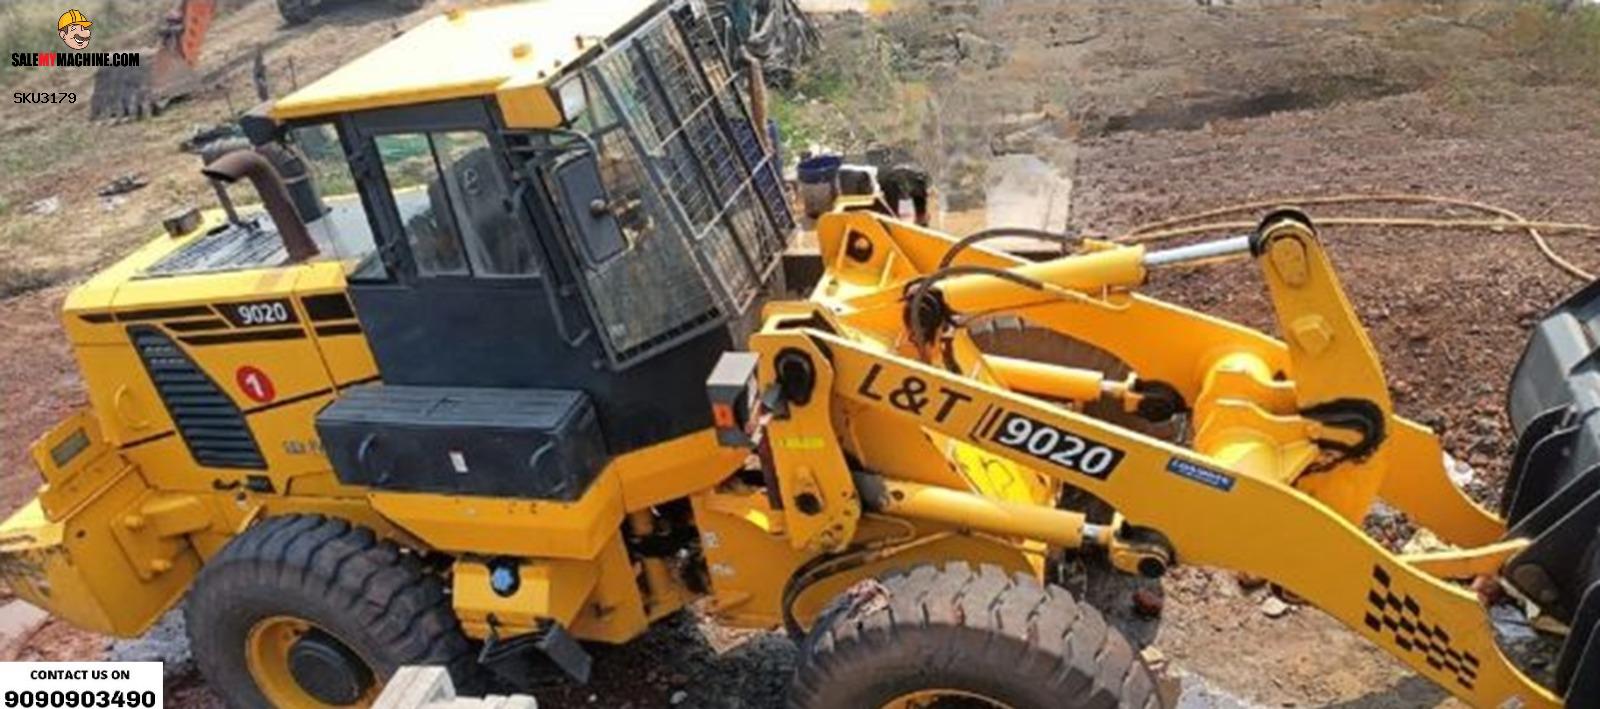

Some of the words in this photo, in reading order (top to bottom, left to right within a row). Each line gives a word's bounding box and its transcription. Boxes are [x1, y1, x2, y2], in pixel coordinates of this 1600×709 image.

[238, 302, 288, 325] 9020
[244, 373, 265, 398] 1
[857, 363, 973, 423] L&T
[999, 416, 1115, 475] 9020
